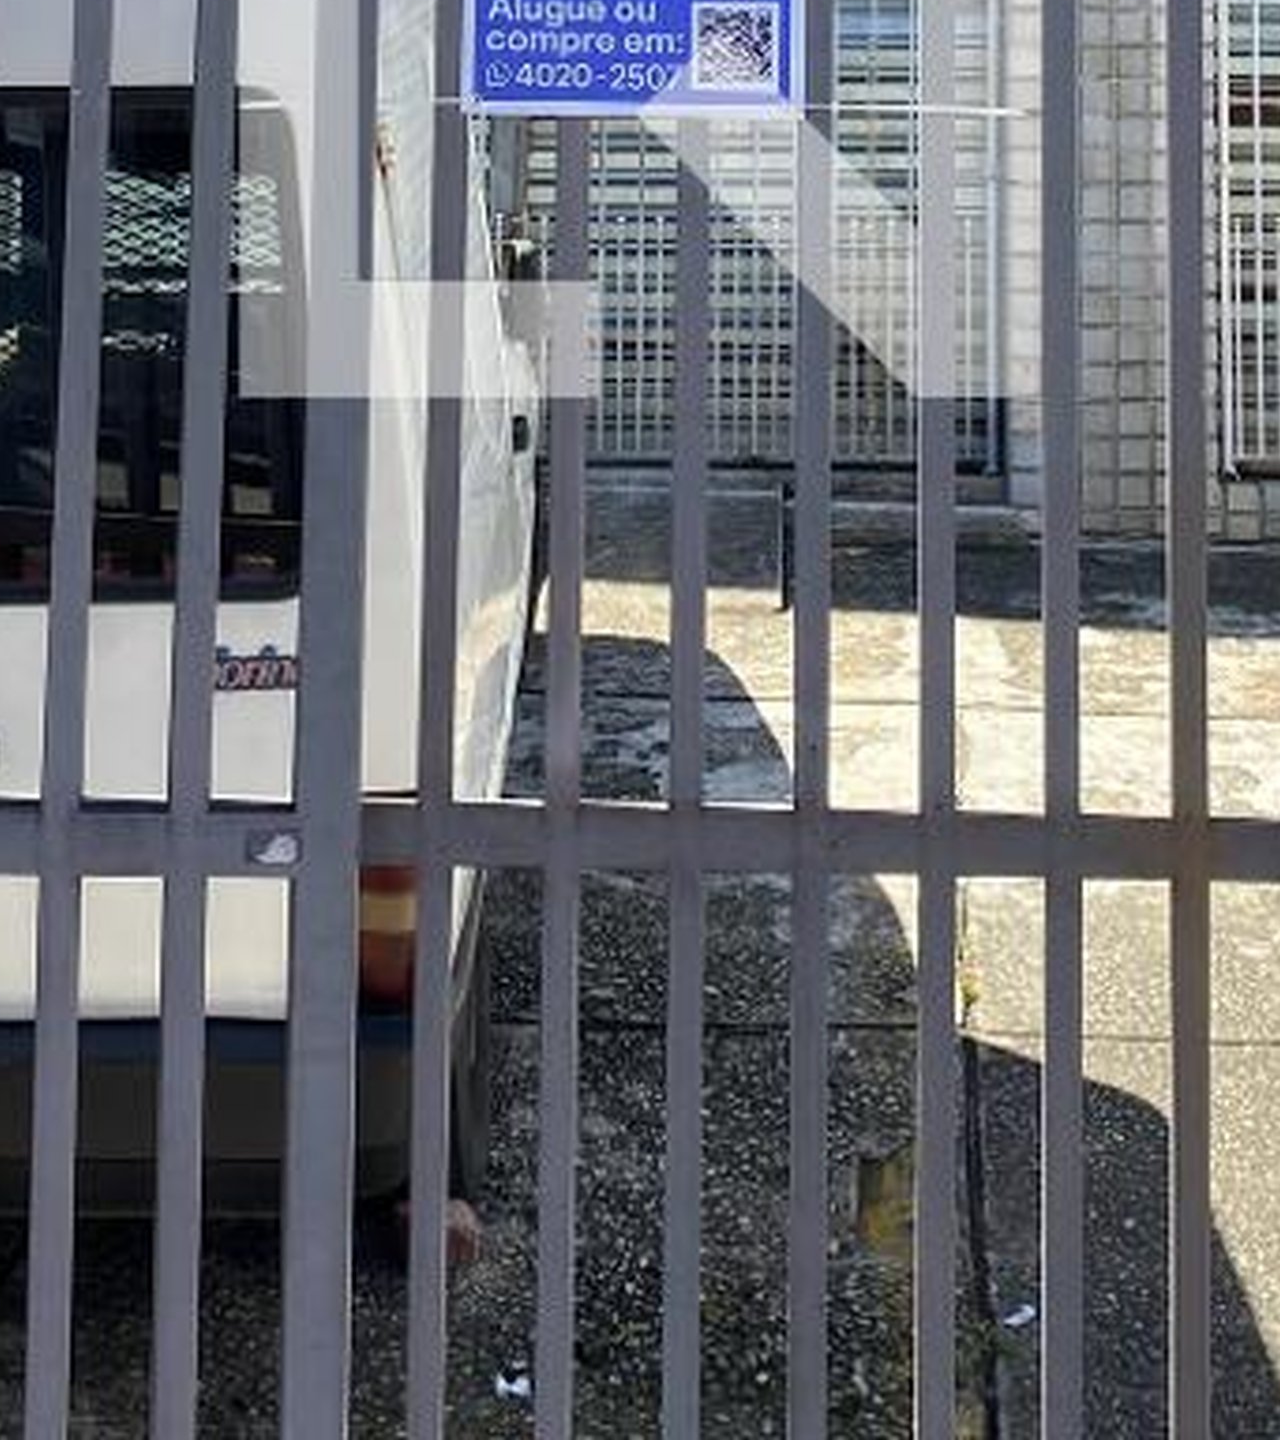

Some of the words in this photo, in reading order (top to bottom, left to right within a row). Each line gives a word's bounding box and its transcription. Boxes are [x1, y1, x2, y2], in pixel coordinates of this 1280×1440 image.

[614, 1, 657, 24] ou
[486, 30, 616, 58] compre
[623, 32, 686, 55] em:
